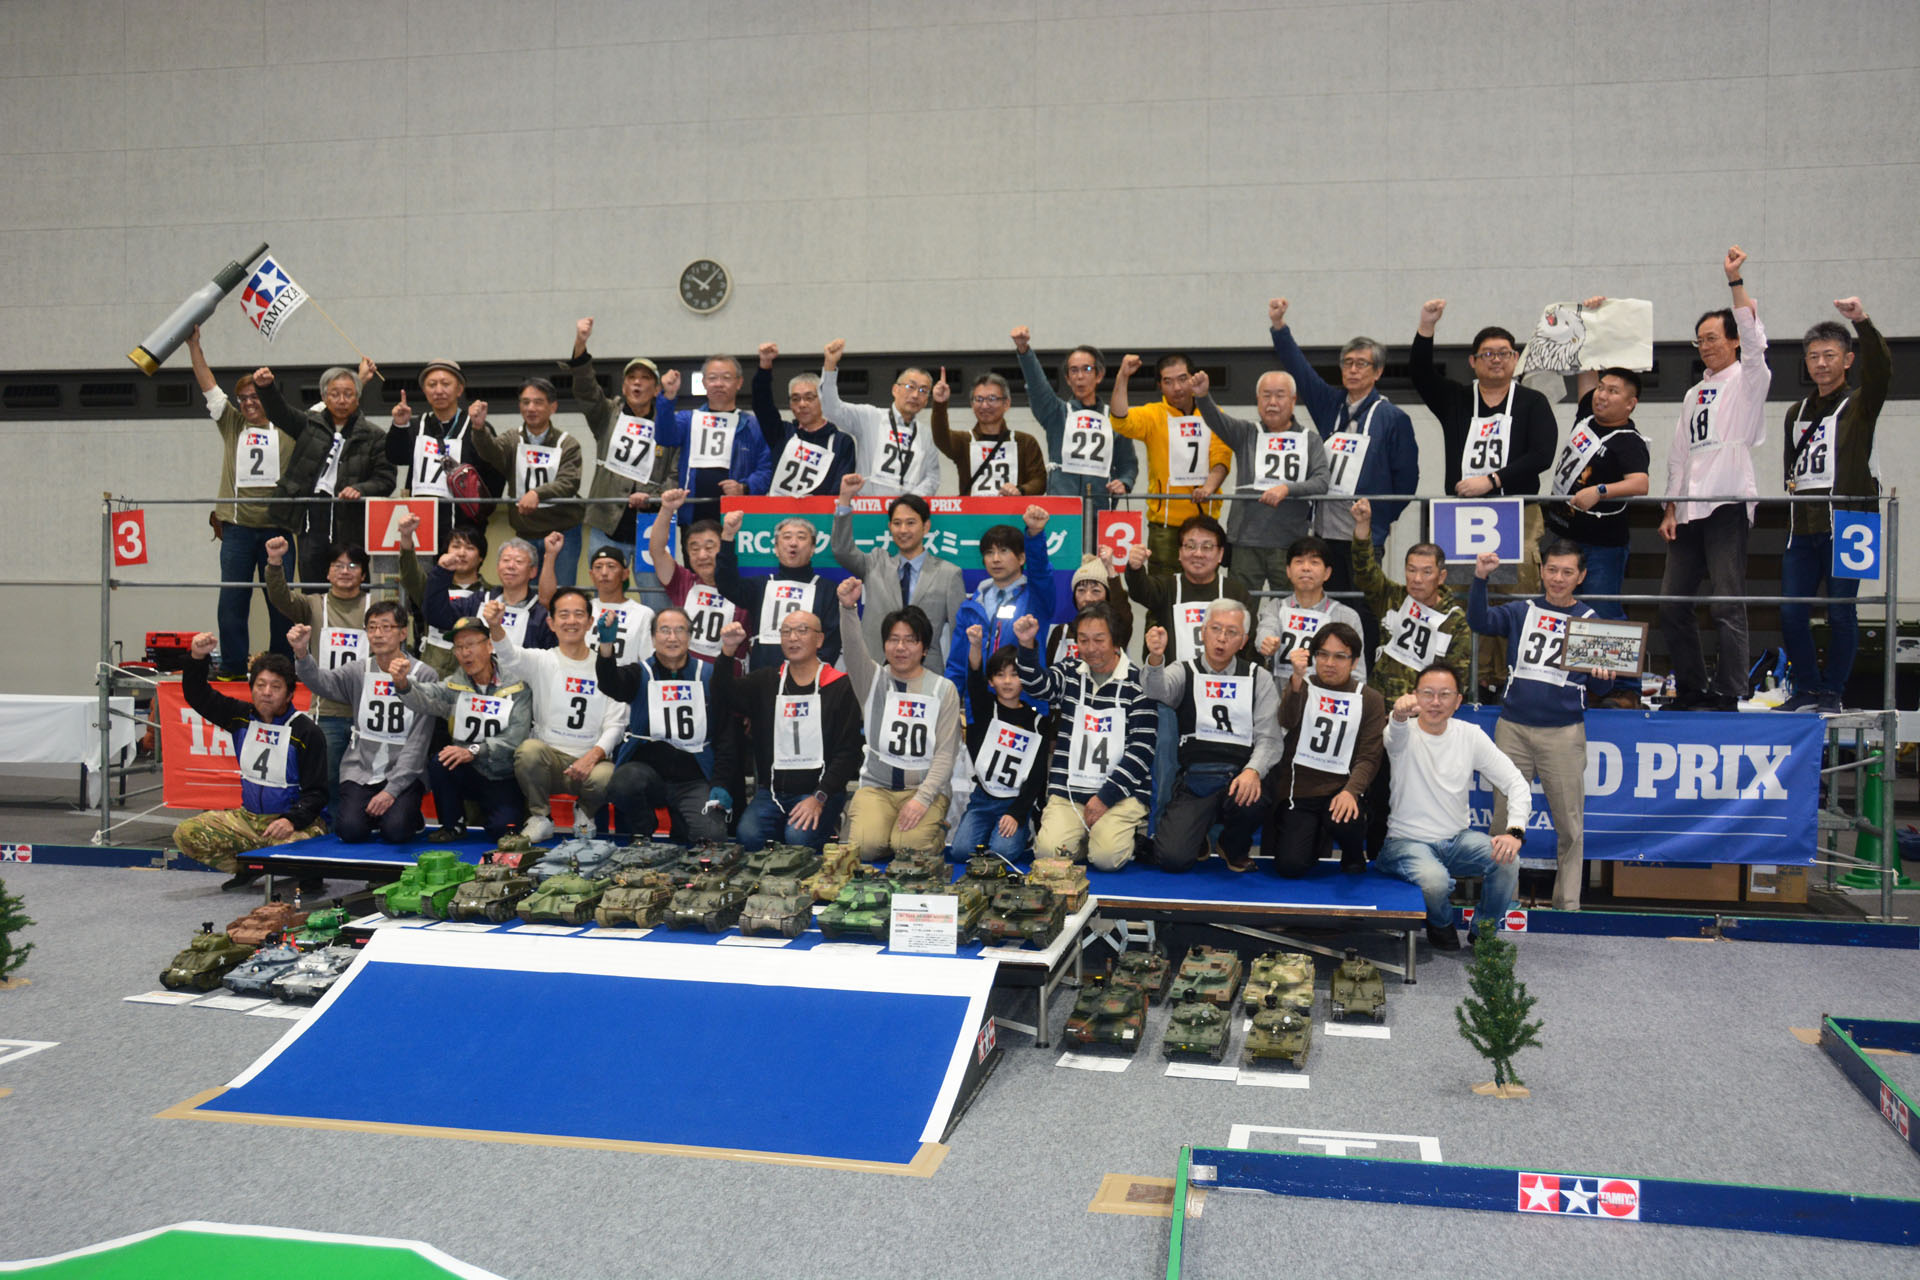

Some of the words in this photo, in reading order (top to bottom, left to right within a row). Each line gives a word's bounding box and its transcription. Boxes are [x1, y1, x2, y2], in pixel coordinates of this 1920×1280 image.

[260, 286, 301, 337] TAMIYA
[1690, 408, 1708, 443] 18
[615, 434, 650, 467] 37
[700, 430, 726, 456] 13
[1071, 432, 1105, 462] 22
[1187, 442, 1199, 473] 7
[1470, 440, 1502, 469] 33
[250, 448, 264, 475] 2
[419, 456, 443, 484] 17
[779, 461, 819, 492] 25
[978, 463, 1010, 491] 23
[1265, 454, 1299, 482] 26
[1555, 446, 1580, 486] 34
[1797, 444, 1827, 477] 36
[834, 498, 882, 512] MIYA
[930, 498, 962, 512] PRIX
[118, 520, 142, 559] 3
[382, 504, 420, 547] A
[1455, 507, 1501, 555] B
[1105, 522, 1135, 566] 3
[1840, 524, 1874, 571] 3
[692, 610, 724, 642] 40
[1397, 618, 1431, 660] 29
[1523, 632, 1563, 669] 32
[367, 700, 404, 733] 38
[567, 695, 587, 729] 3
[663, 706, 695, 740] 16
[793, 721, 800, 755] 1
[889, 720, 927, 757] 30
[1310, 716, 1348, 757] 31
[252, 748, 271, 779] 4
[985, 750, 1021, 787] 15
[1079, 735, 1110, 773] 14
[1634, 742, 1792, 800] PRIX
